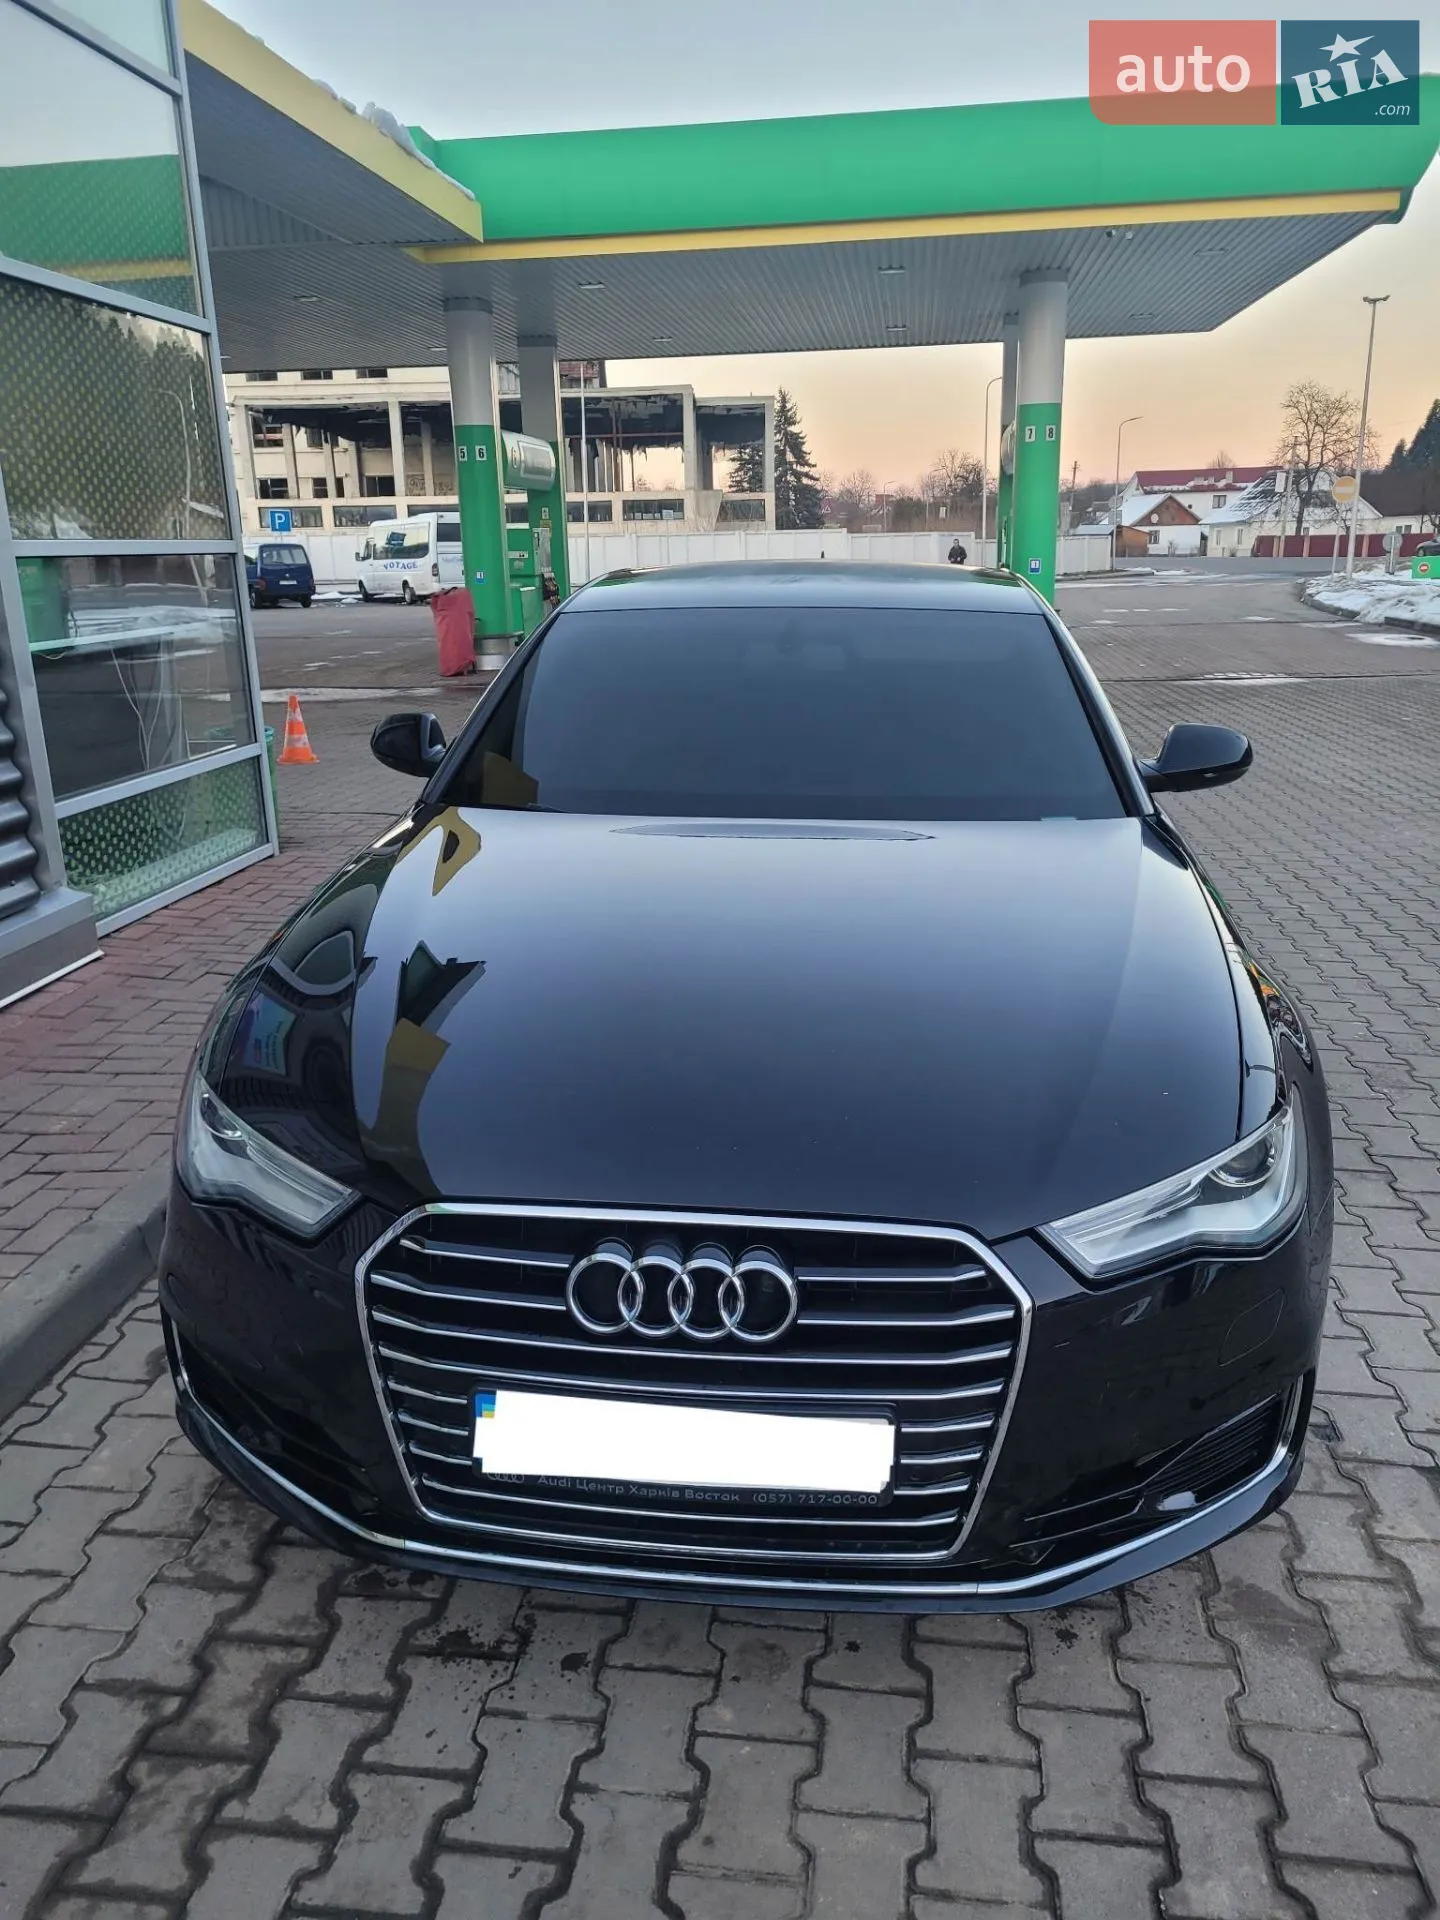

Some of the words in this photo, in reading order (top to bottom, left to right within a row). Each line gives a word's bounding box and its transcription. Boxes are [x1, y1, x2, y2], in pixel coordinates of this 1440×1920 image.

[478, 447, 485, 459] 6
[275, 513, 286, 530] P
[537, 1475, 571, 1488] Audi
[576, 1479, 624, 1494] Центр
[628, 1484, 680, 1498] Харків
[685, 1489, 740, 1501] Восток
[752, 1493, 792, 1503] (057)
[799, 1494, 877, 1505] 717-00-00
